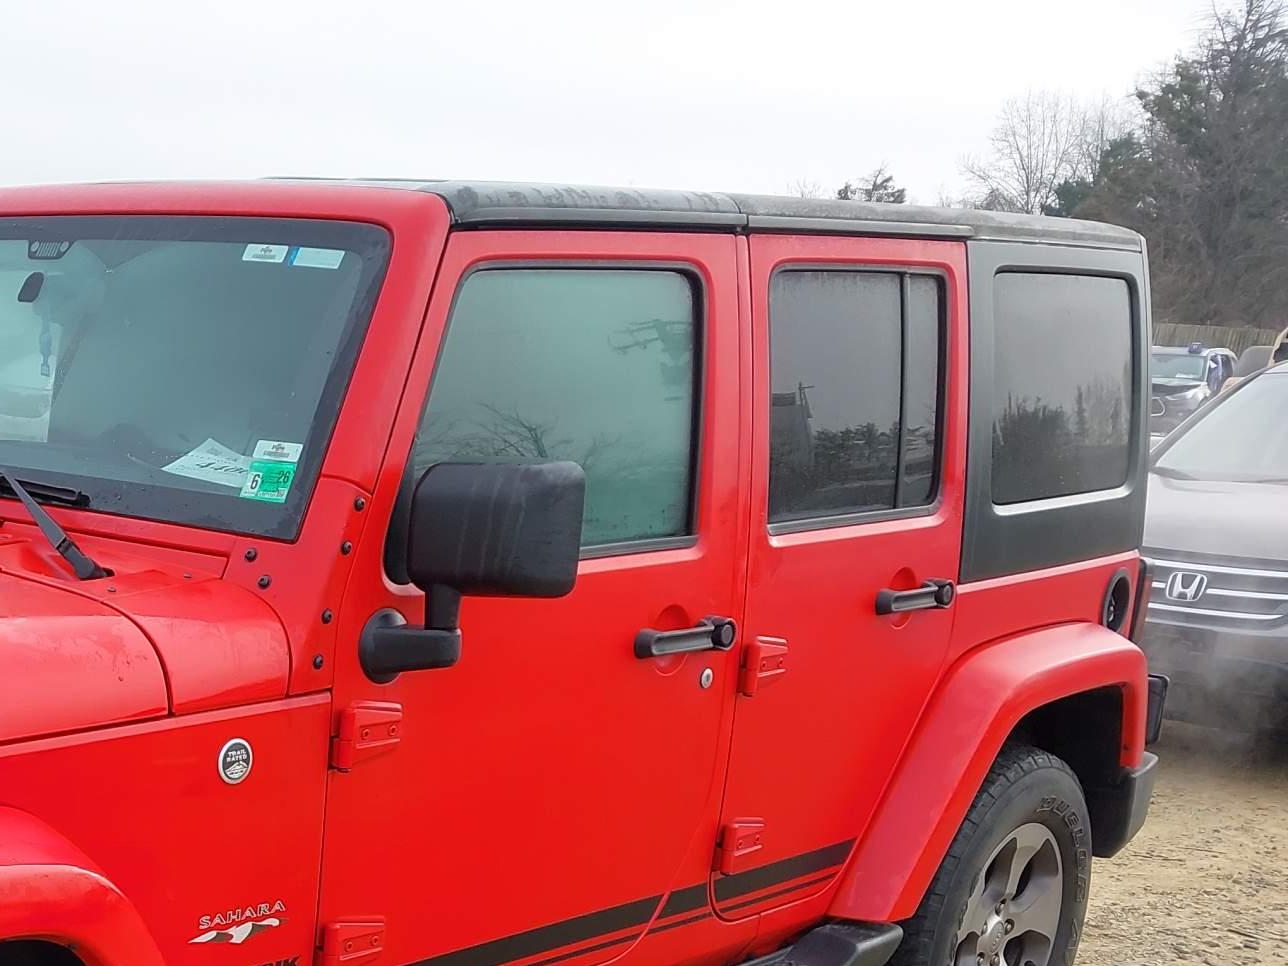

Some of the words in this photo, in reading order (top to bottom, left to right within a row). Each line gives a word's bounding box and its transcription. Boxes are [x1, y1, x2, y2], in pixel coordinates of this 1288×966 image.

[250, 474, 261, 490] 6
[278, 470, 291, 484] 26
[226, 753, 248, 763] RATED
[228, 749, 247, 757] TRAIL
[199, 899, 287, 930] SAHARA
